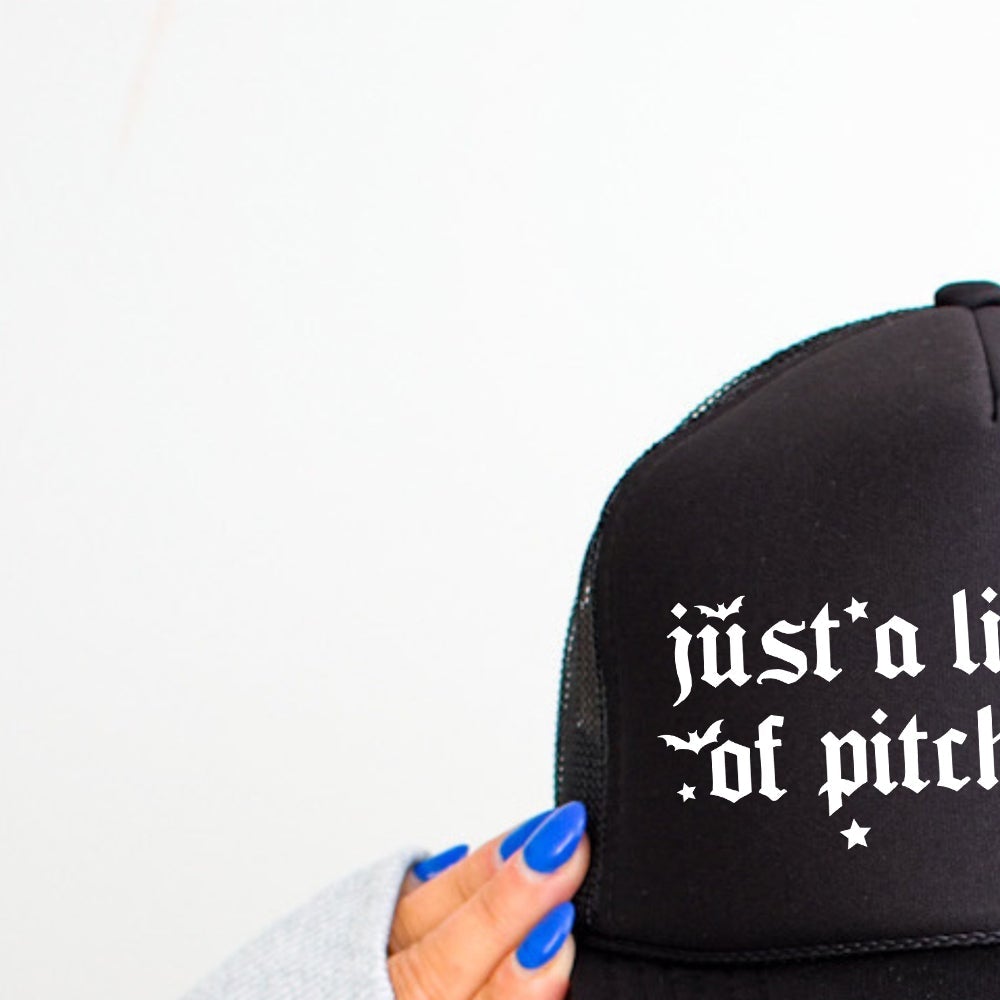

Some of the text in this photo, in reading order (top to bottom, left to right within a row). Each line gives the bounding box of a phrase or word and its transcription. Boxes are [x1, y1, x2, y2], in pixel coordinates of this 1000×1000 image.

[666, 602, 843, 707] just
[874, 614, 926, 680] a
[709, 714, 788, 804] of
